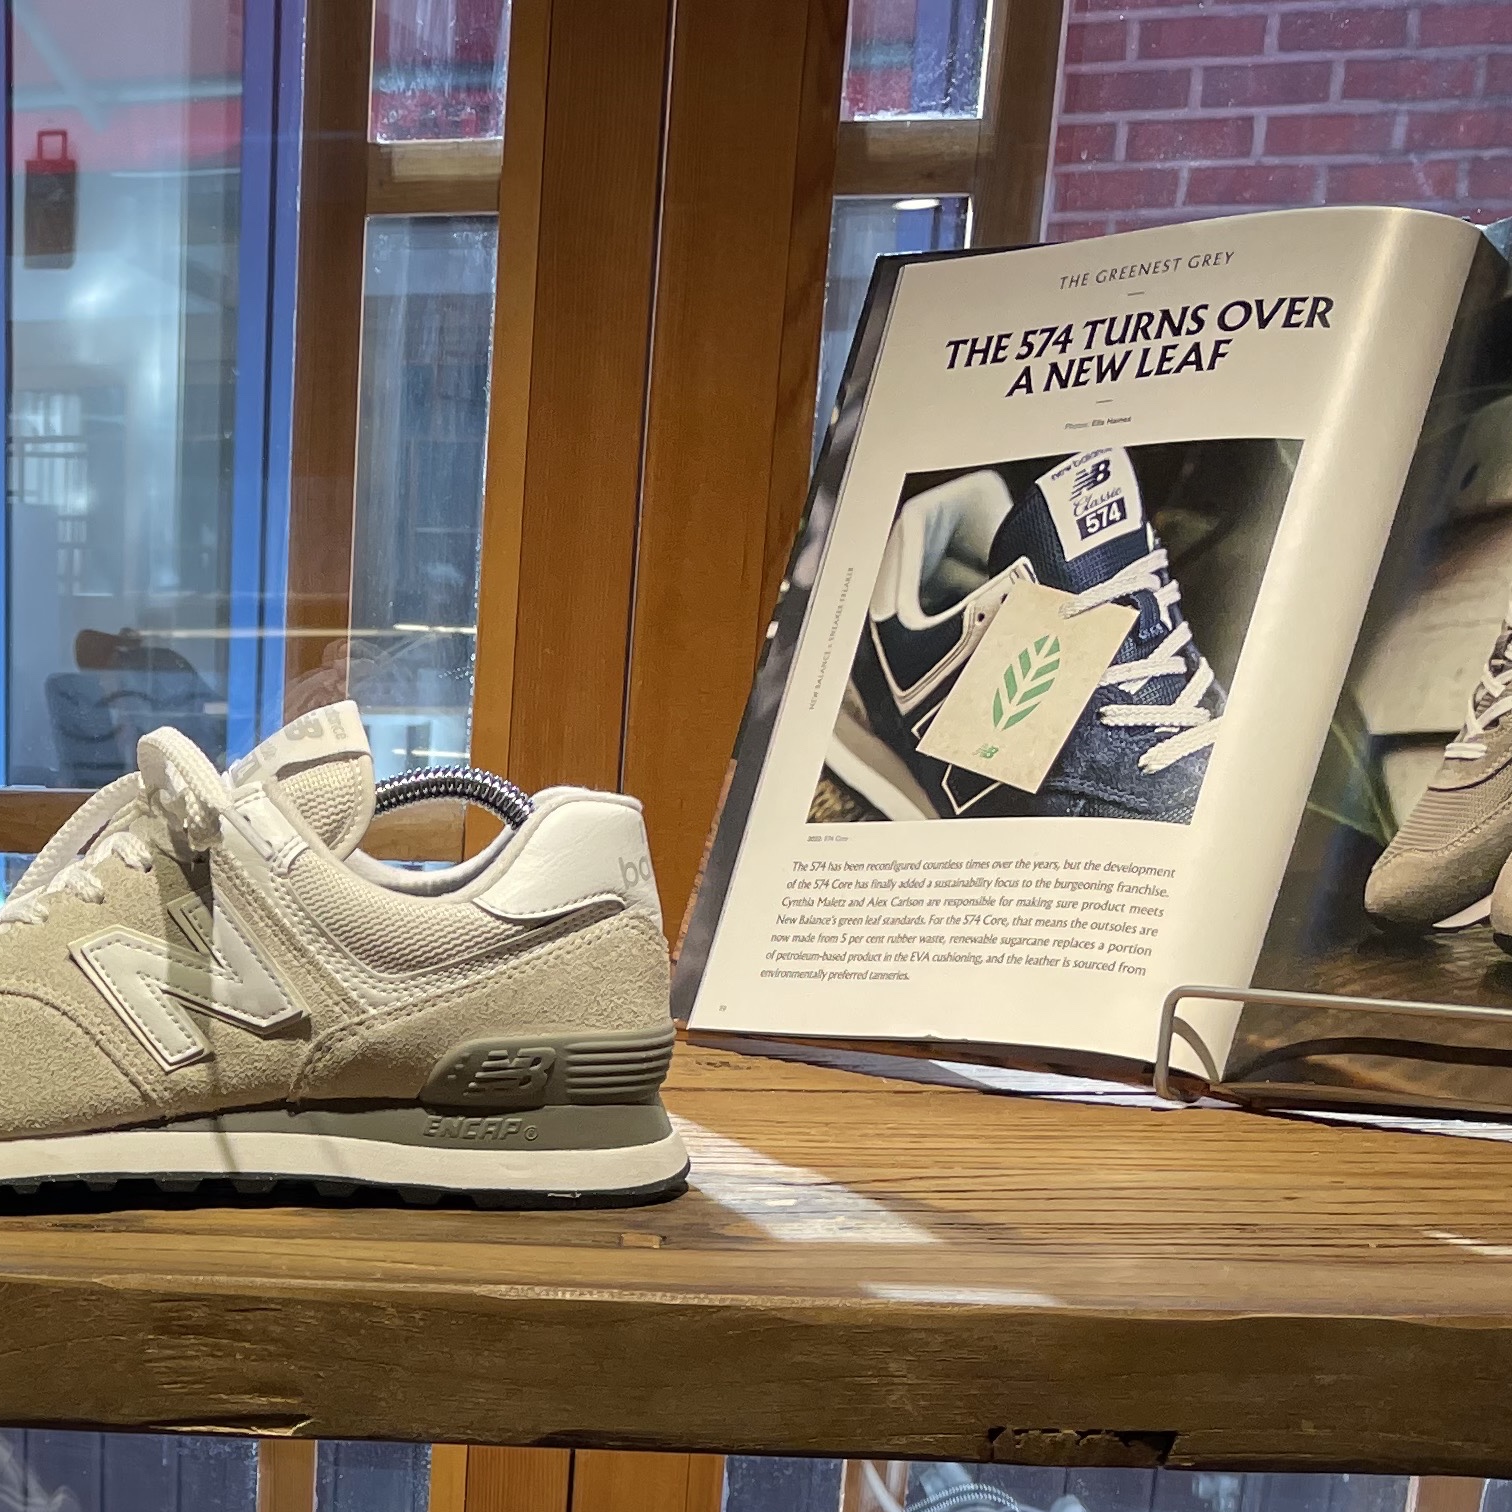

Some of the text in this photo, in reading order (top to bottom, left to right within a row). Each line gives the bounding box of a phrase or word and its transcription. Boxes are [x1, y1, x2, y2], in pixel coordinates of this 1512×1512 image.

[1059, 251, 1235, 291] THE GREENEST GREY
[945, 296, 1335, 370] THE 574 TURNS OVER
[1005, 338, 1234, 398] A NEW LEAF
[1085, 501, 1122, 534] 574
[793, 859, 1176, 878] The 574 has been reconfigured countless times over the years, but the development
[787, 879, 798, 889] of
[798, 879, 811, 889] the
[813, 879, 830, 889] 574
[832, 879, 853, 889] Core
[854, 879, 869, 889] has
[871, 878, 897, 891] finally
[898, 878, 925, 888] added
[934, 877, 992, 891] sustainability
[994, 877, 1020, 888] focus
[1022, 878, 1032, 888] to
[1035, 878, 1051, 888] the
[1054, 878, 1114, 893] burgeoning
[1116, 881, 1169, 898] franchise.
[782, 897, 814, 909] Cynthia
[848, 897, 865, 907] and
[867, 897, 888, 907] Alex
[926, 899, 939, 907] are
[943, 897, 996, 908] responsible
[999, 896, 1014, 907] for
[1015, 896, 1053, 909] making
[1055, 899, 1078, 909] sure
[1081, 900, 1125, 913] product
[1129, 904, 1164, 917] meets
[776, 915, 797, 925] New
[839, 917, 863, 927] green
[865, 915, 882, 925] leaf
[882, 915, 926, 925] standards.
[929, 915, 943, 925] For
[945, 915, 961, 925] the
[963, 914, 981, 925] 574
[983, 914, 1009, 927] Core,
[1012, 915, 1033, 927] that
[1035, 918, 1068, 928] means
[1070, 918, 1088, 929] the
[1090, 922, 1137, 934] outsoles
[1139, 926, 1159, 937] are
